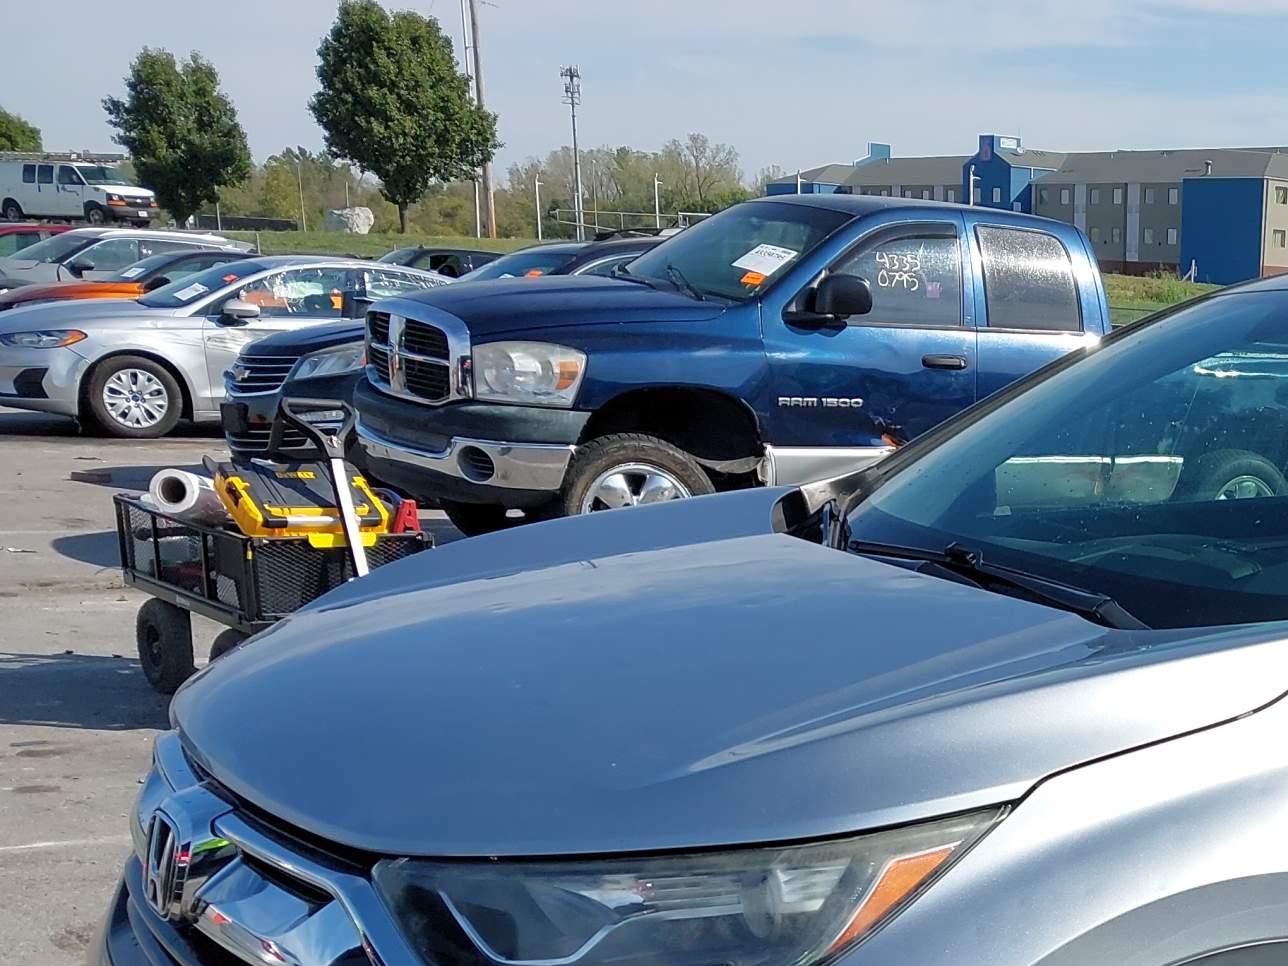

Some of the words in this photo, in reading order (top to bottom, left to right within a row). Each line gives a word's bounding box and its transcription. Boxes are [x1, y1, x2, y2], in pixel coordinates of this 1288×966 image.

[876, 251, 921, 271] 4335
[878, 270, 919, 291] 0795
[778, 396, 817, 407] RAM
[821, 397, 864, 408] 1500
